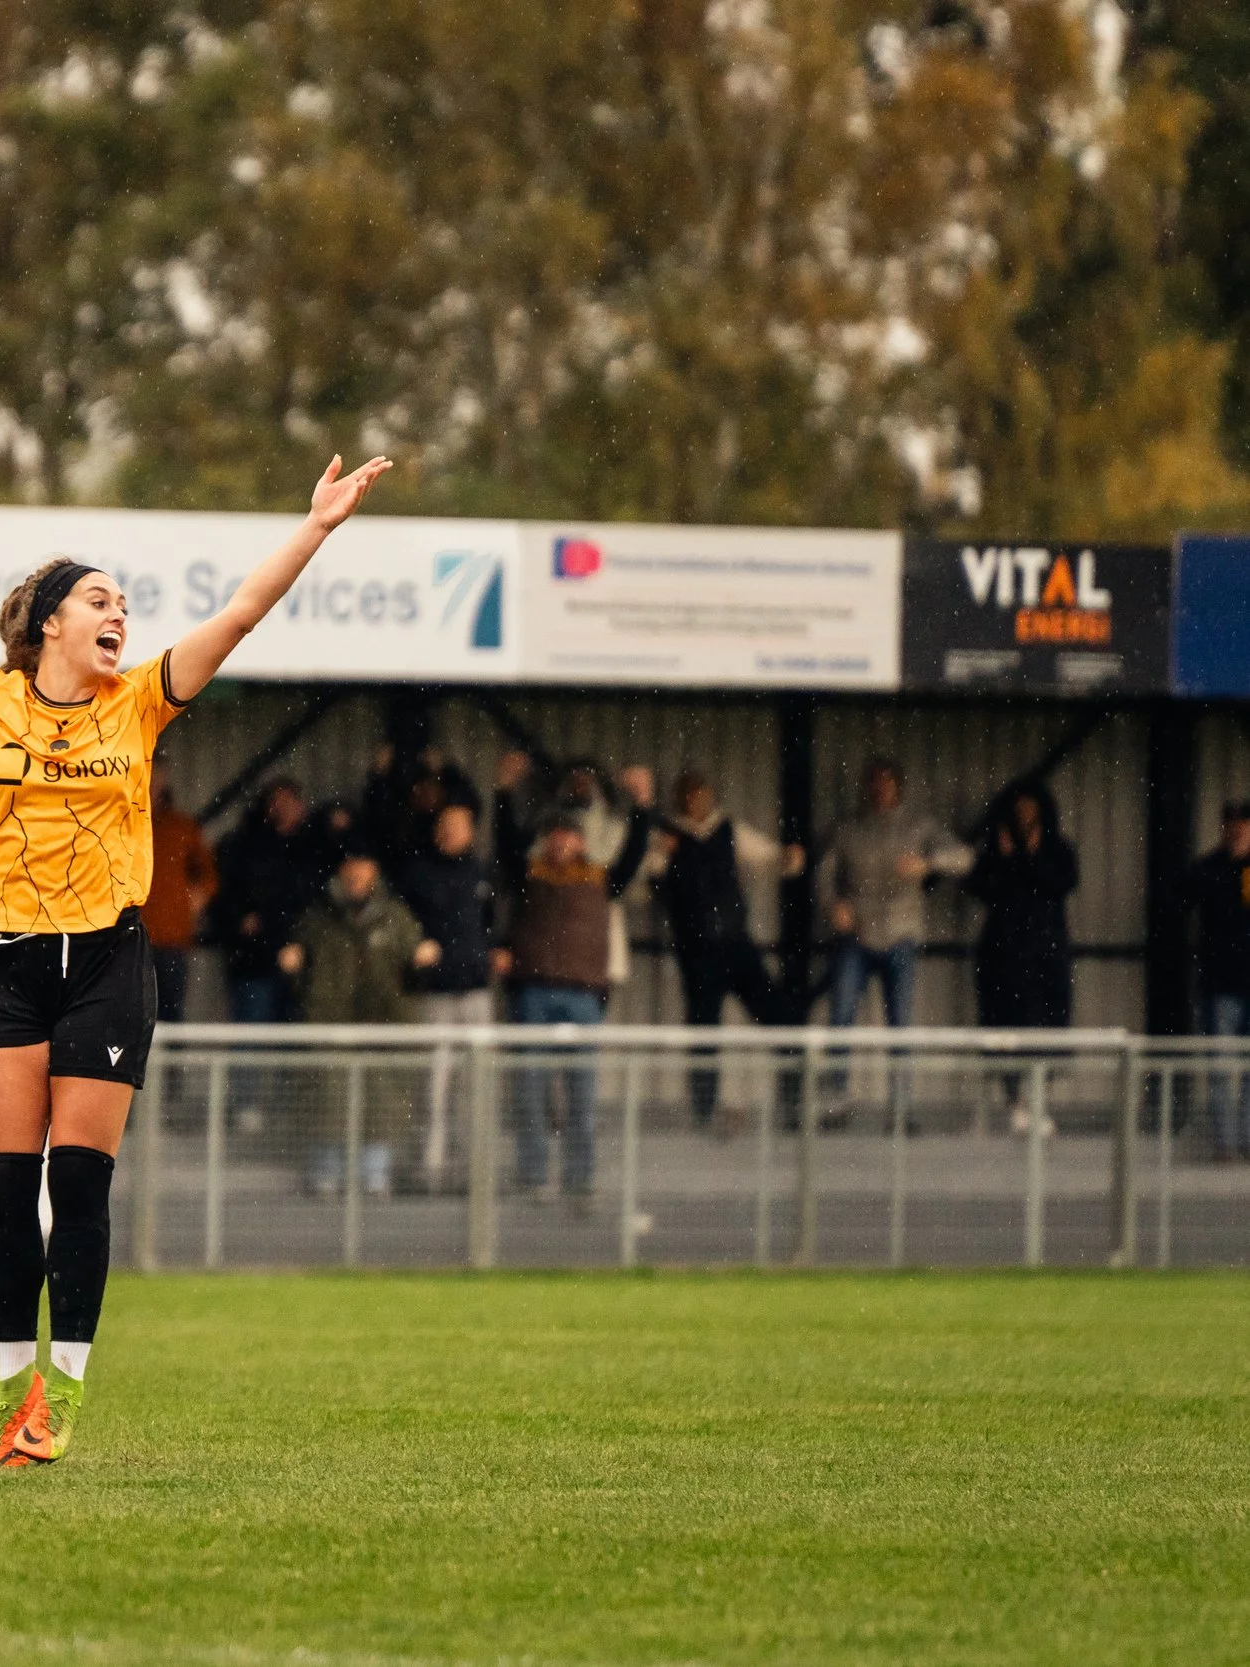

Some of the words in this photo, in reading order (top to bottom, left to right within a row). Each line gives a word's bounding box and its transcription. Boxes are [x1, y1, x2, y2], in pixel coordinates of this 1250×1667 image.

[184, 559, 420, 625] Svices
[960, 545, 1112, 608] VITAL
[43, 755, 130, 782] galaxy
